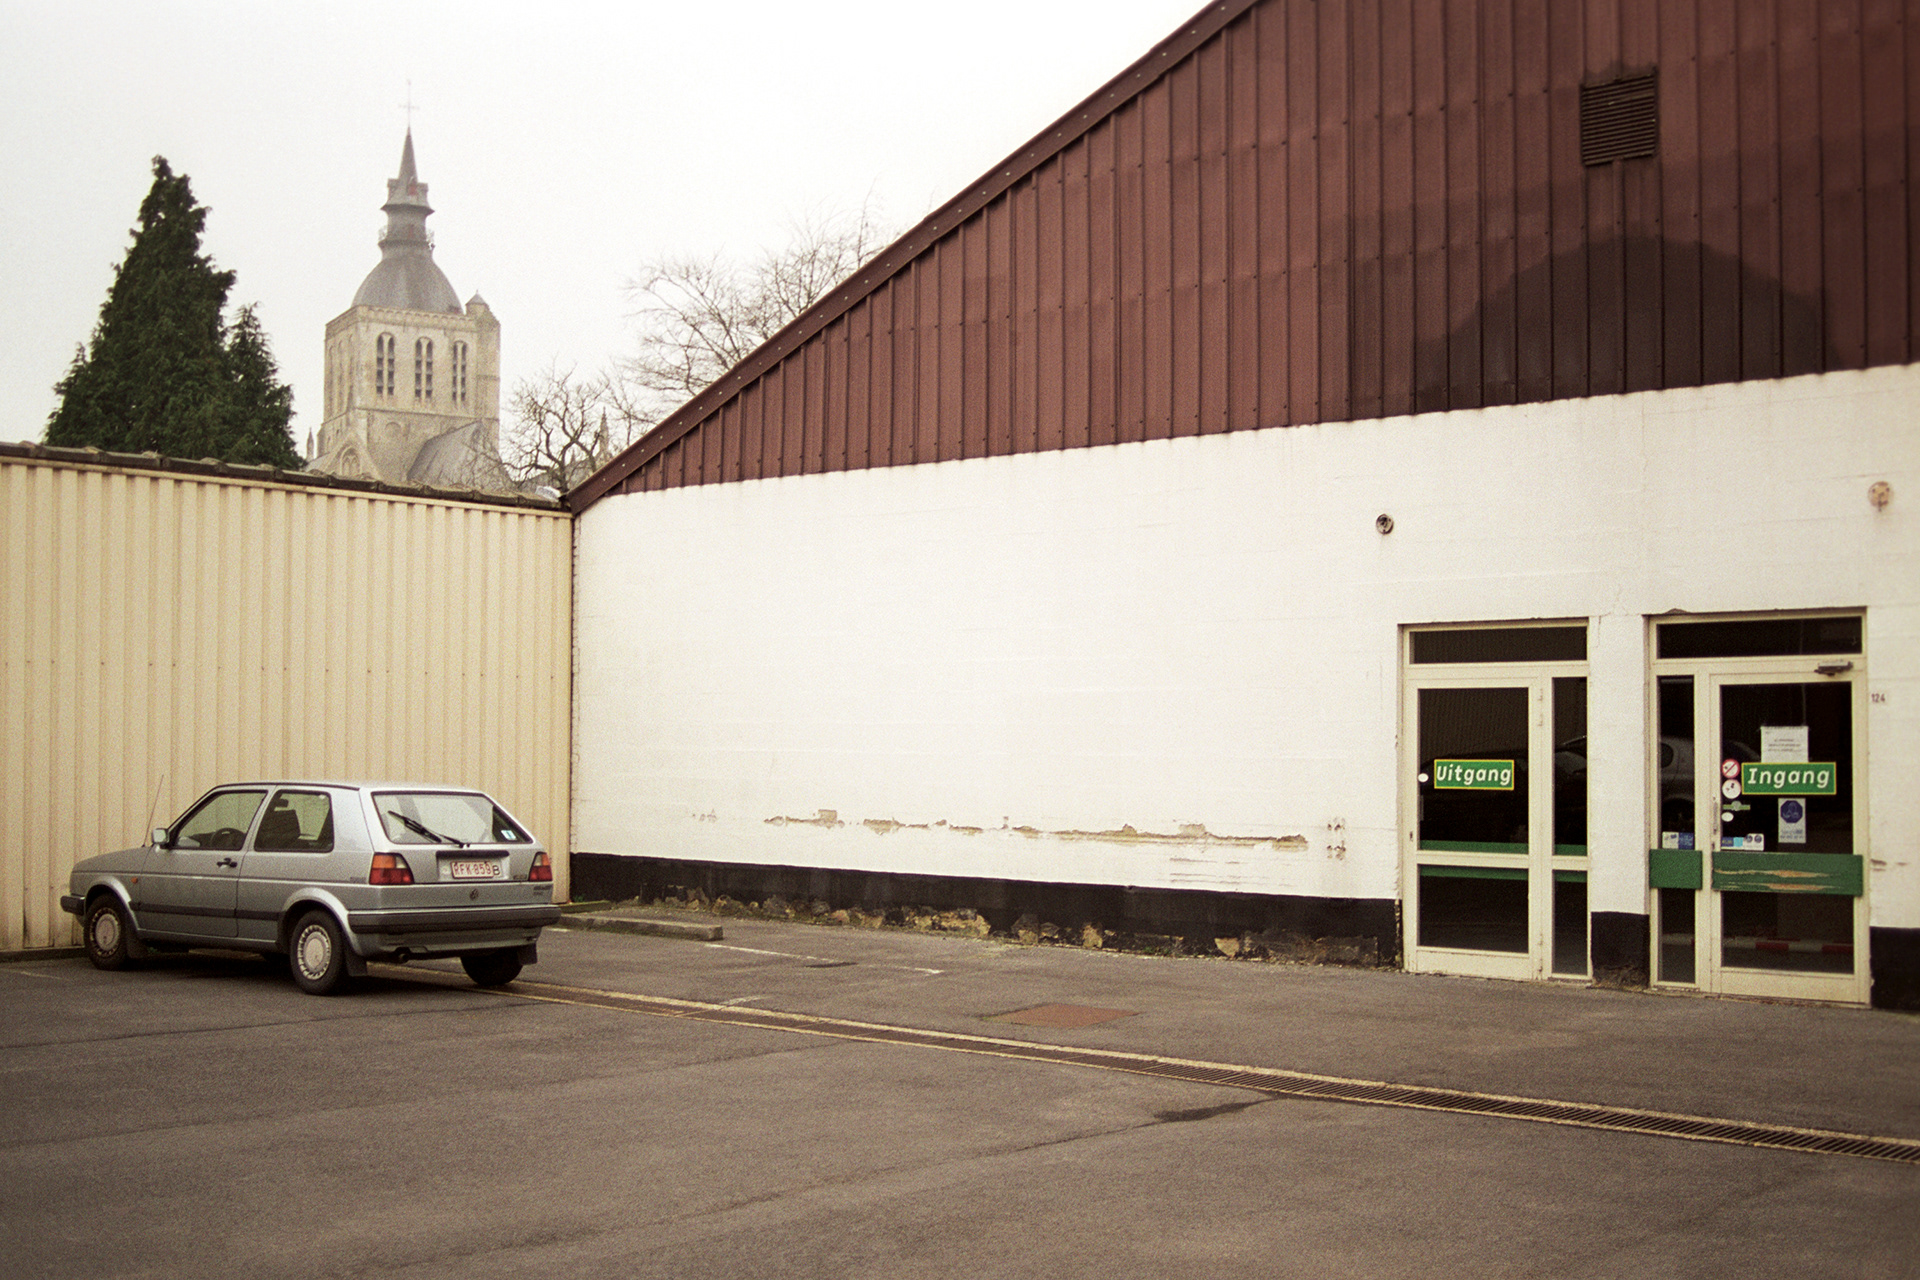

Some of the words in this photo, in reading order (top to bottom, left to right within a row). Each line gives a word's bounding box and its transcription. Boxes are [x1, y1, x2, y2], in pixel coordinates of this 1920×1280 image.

[1871, 693, 1885, 703] 124
[1436, 763, 1511, 786] Uitgang
[1747, 768, 1830, 789] Ingang
